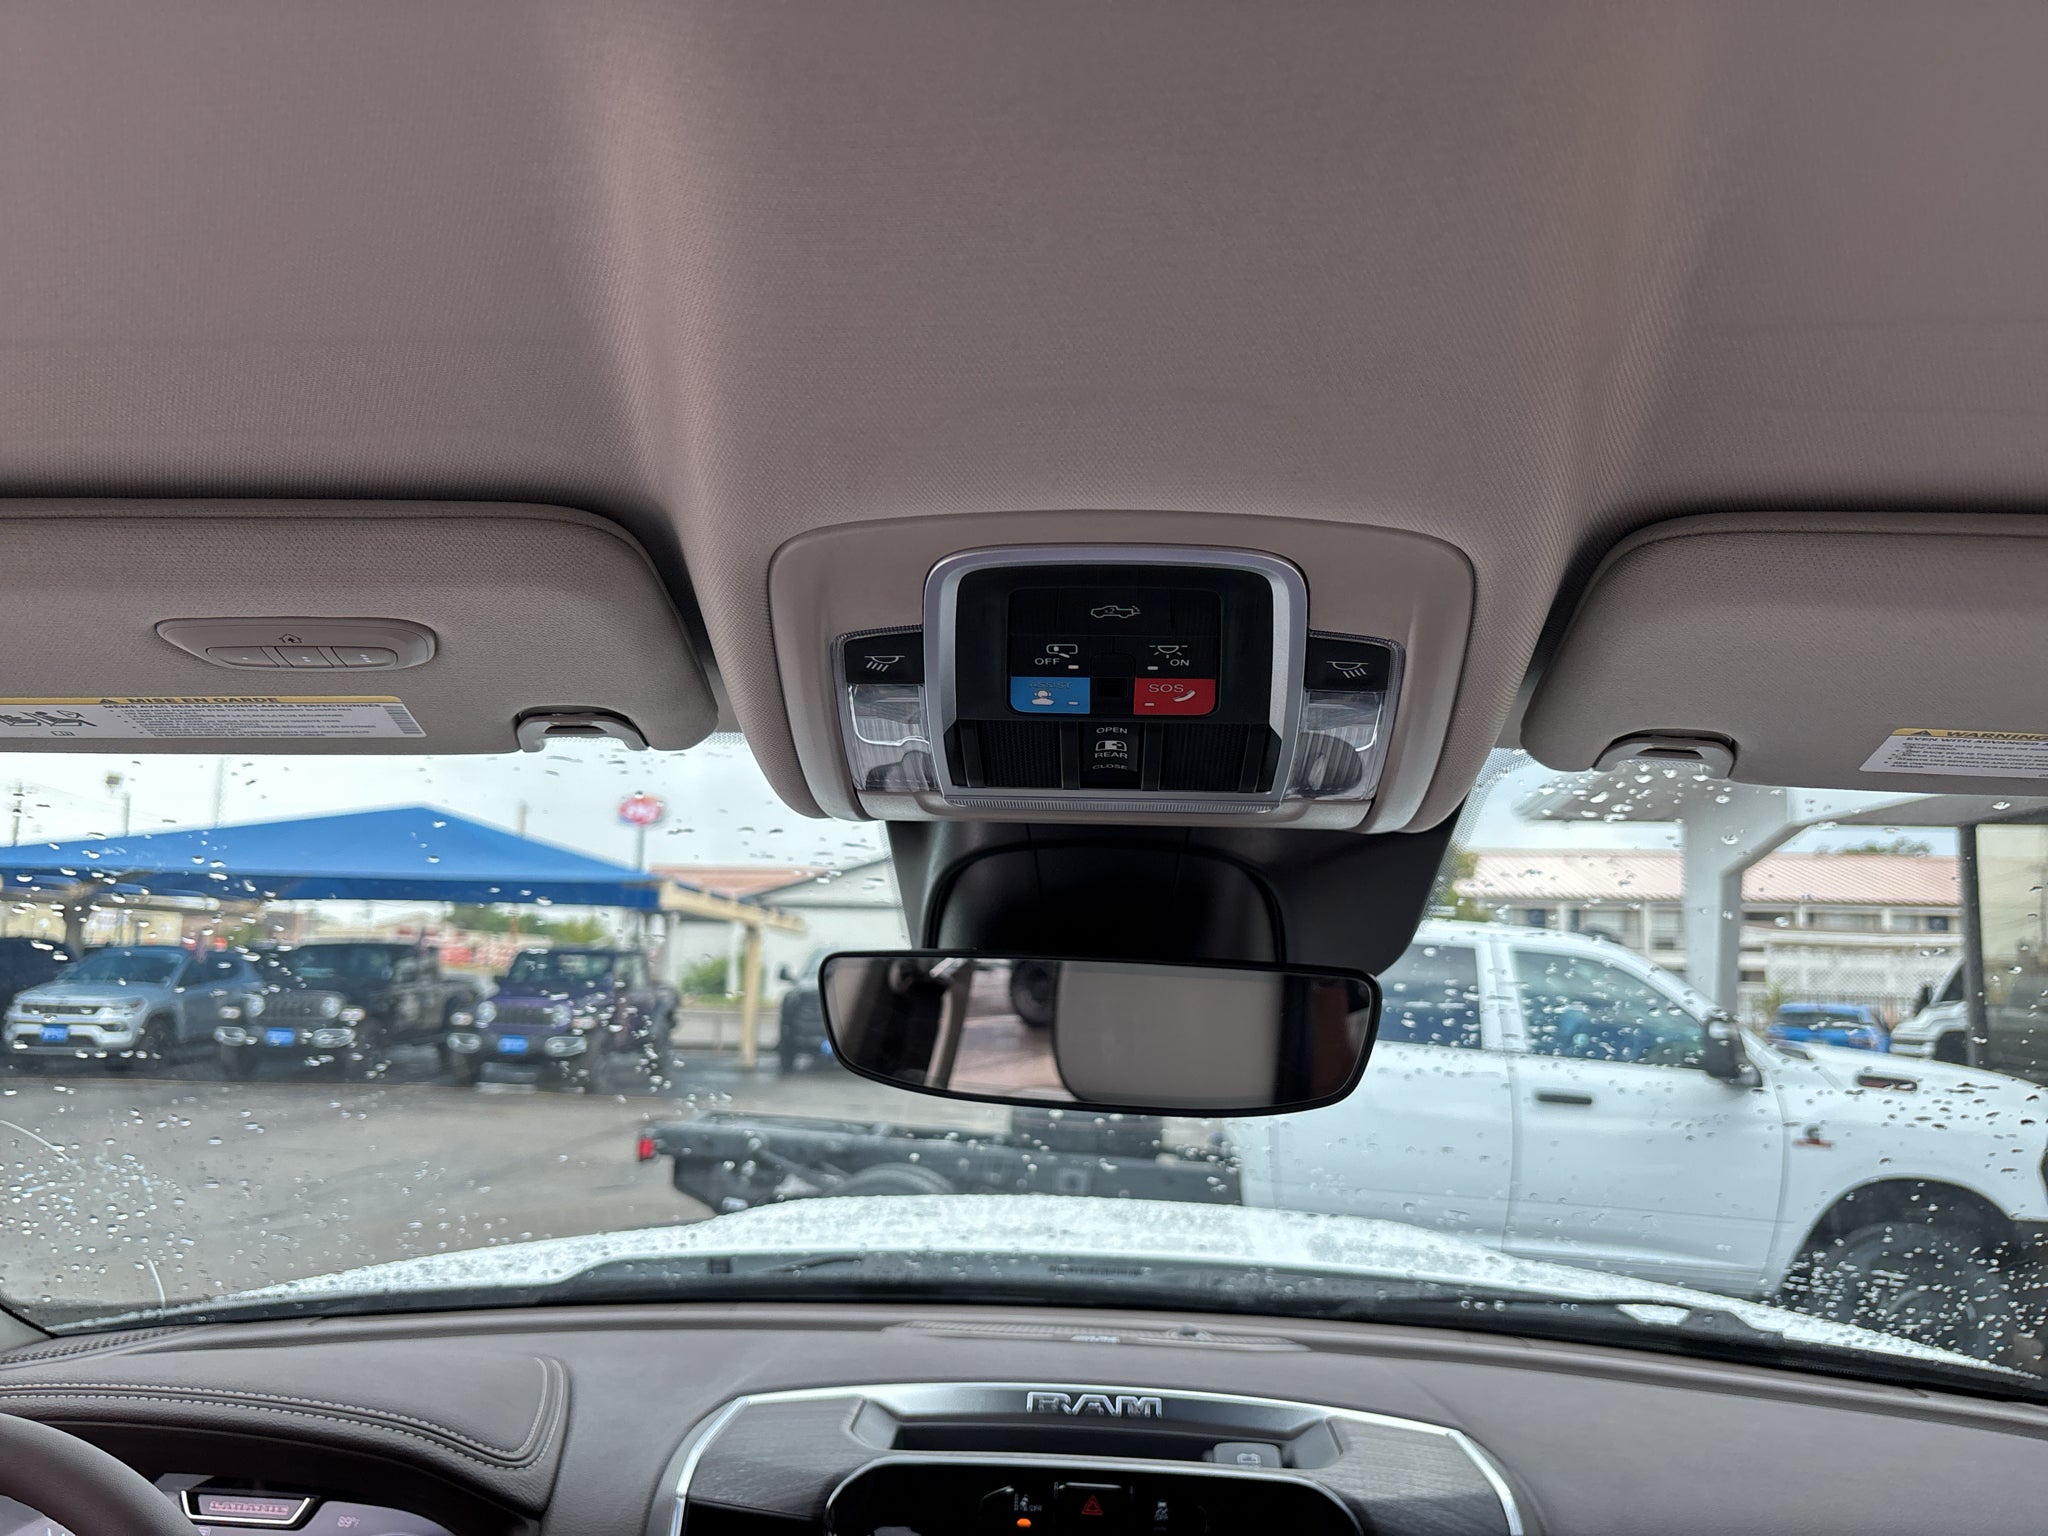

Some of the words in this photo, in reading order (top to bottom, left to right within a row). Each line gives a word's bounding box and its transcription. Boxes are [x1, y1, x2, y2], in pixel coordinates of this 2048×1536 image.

[1034, 657, 1061, 666] OFF
[1169, 658, 1190, 667] ON
[1148, 683, 1185, 693] SOS
[1096, 726, 1128, 734] OPEN
[1946, 731, 2048, 741] WARNING
[1094, 751, 1128, 760] REAR
[1092, 763, 1128, 771] CLOSE
[1026, 1391, 1163, 1418] RAM
